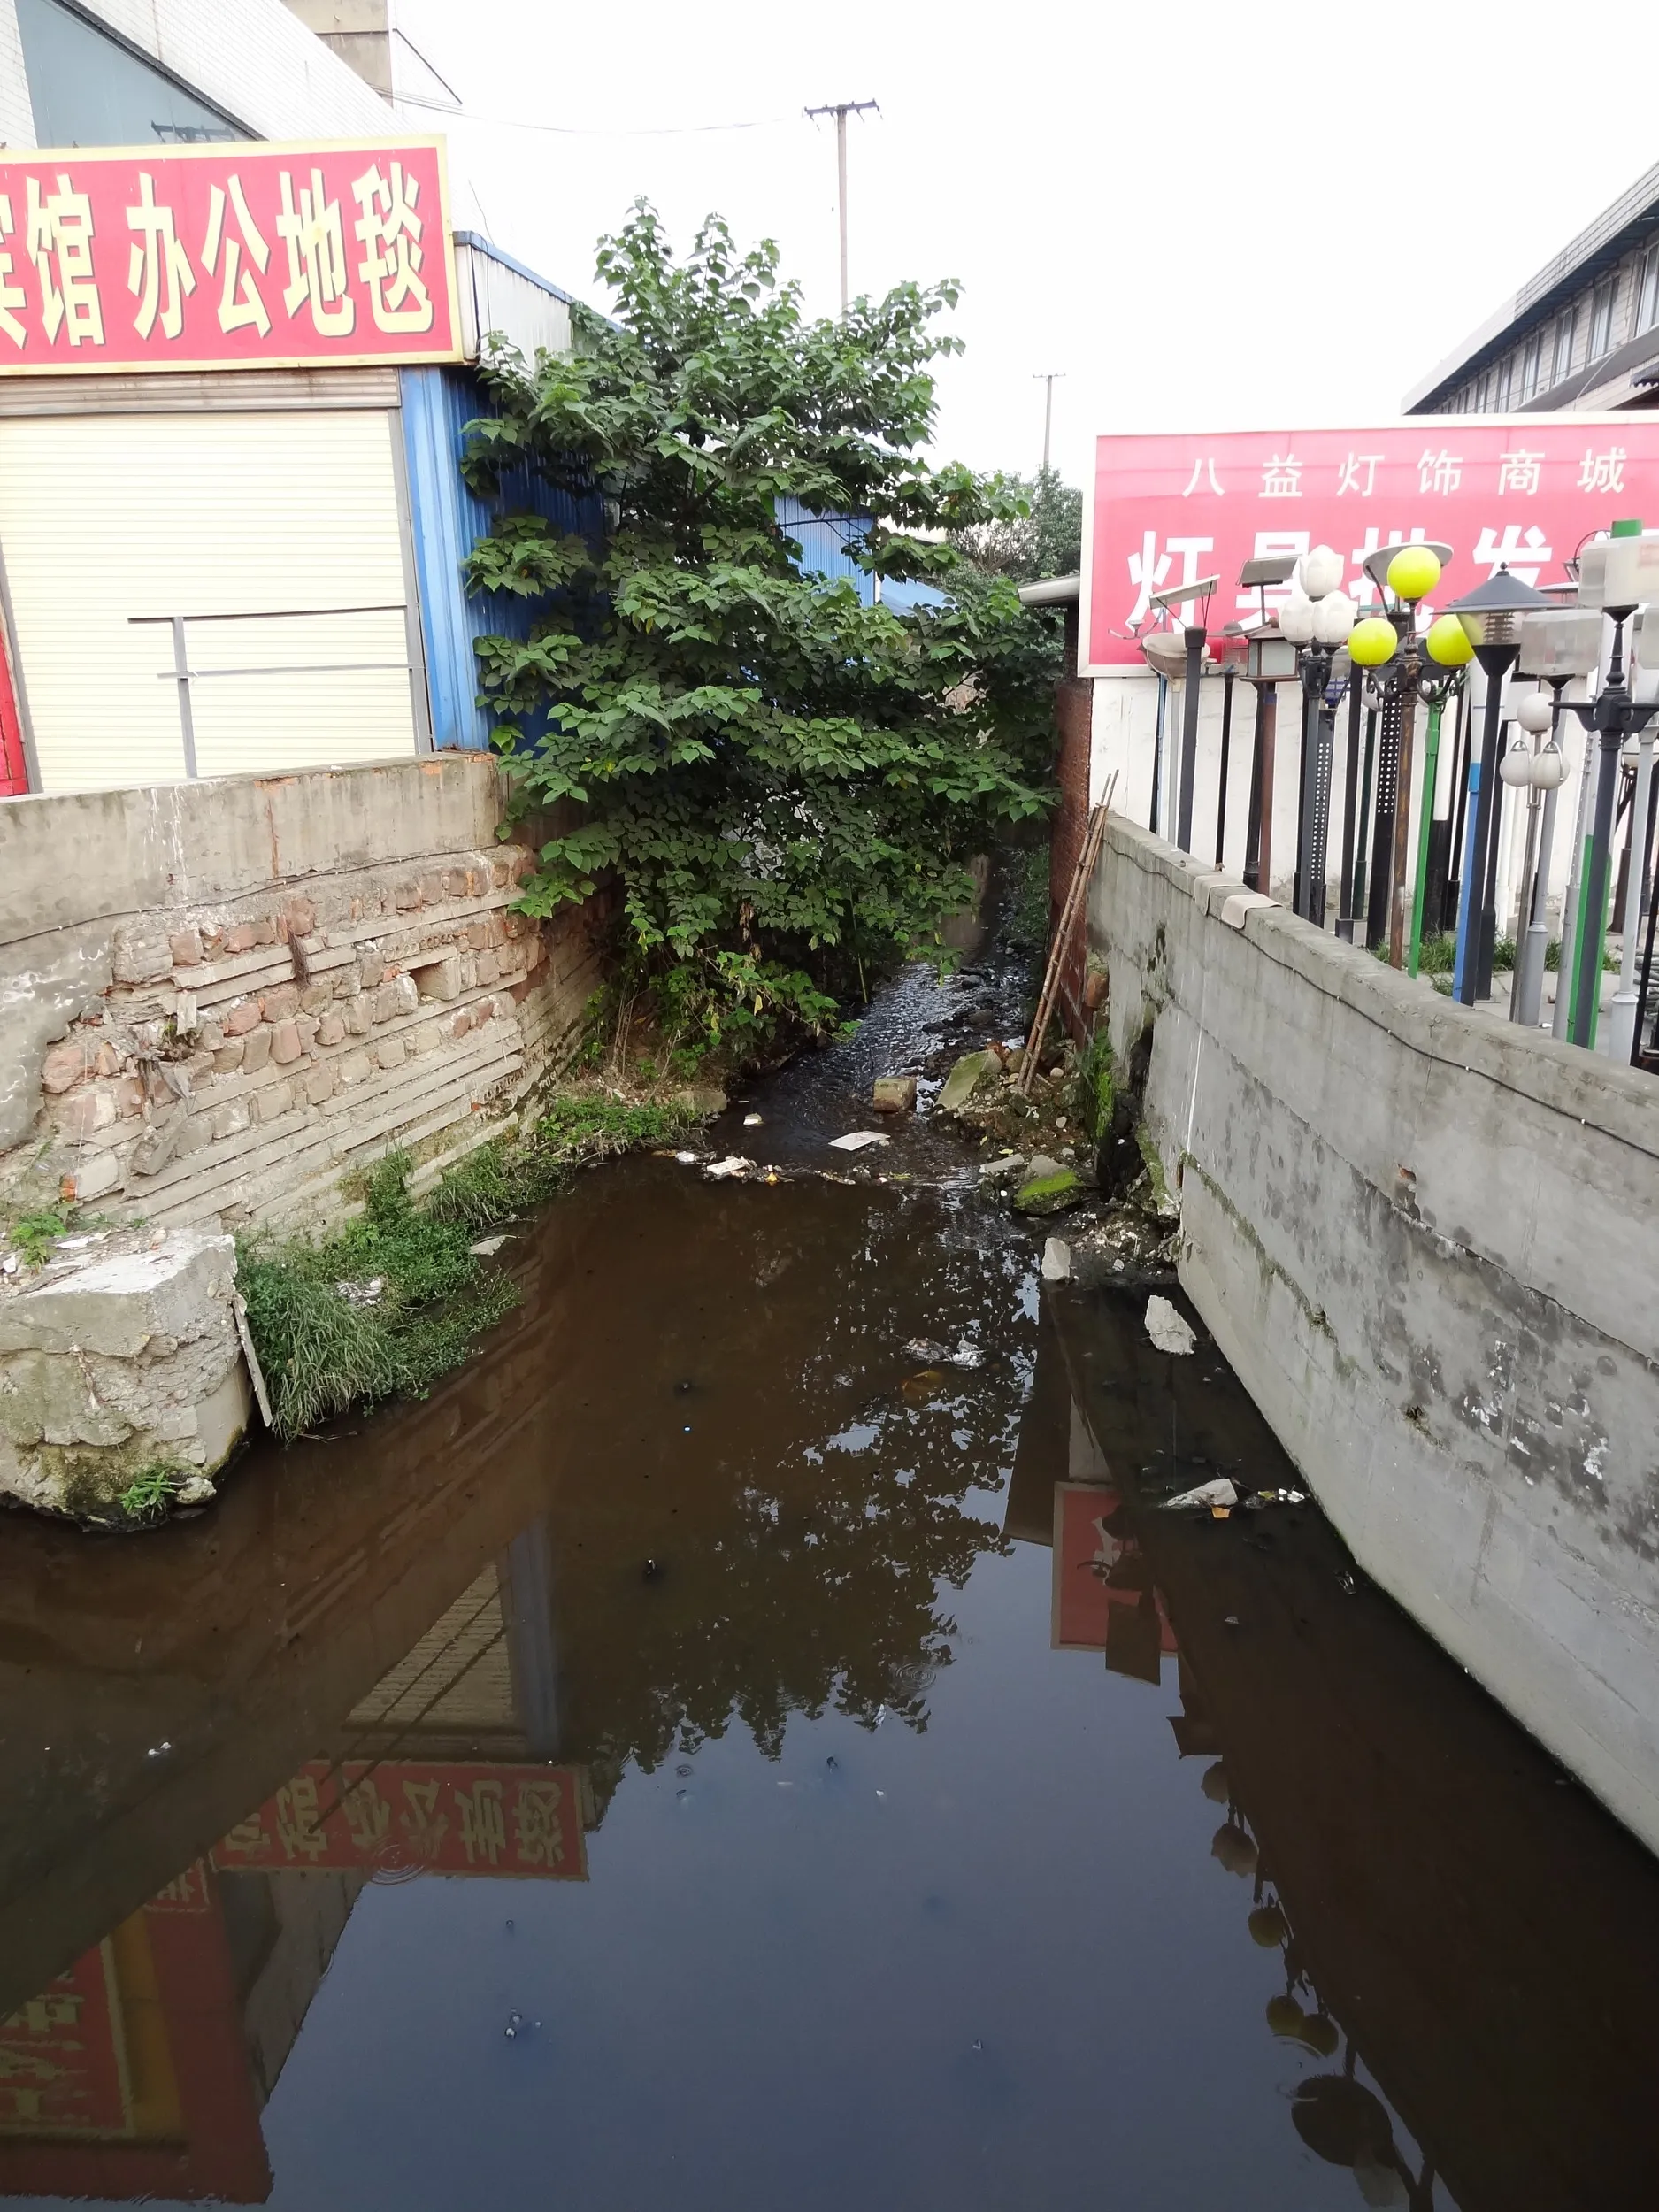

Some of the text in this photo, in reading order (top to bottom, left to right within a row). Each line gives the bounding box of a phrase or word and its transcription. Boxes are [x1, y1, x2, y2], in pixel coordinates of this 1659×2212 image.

[1182, 446, 1629, 498] 八益灯饰商城
